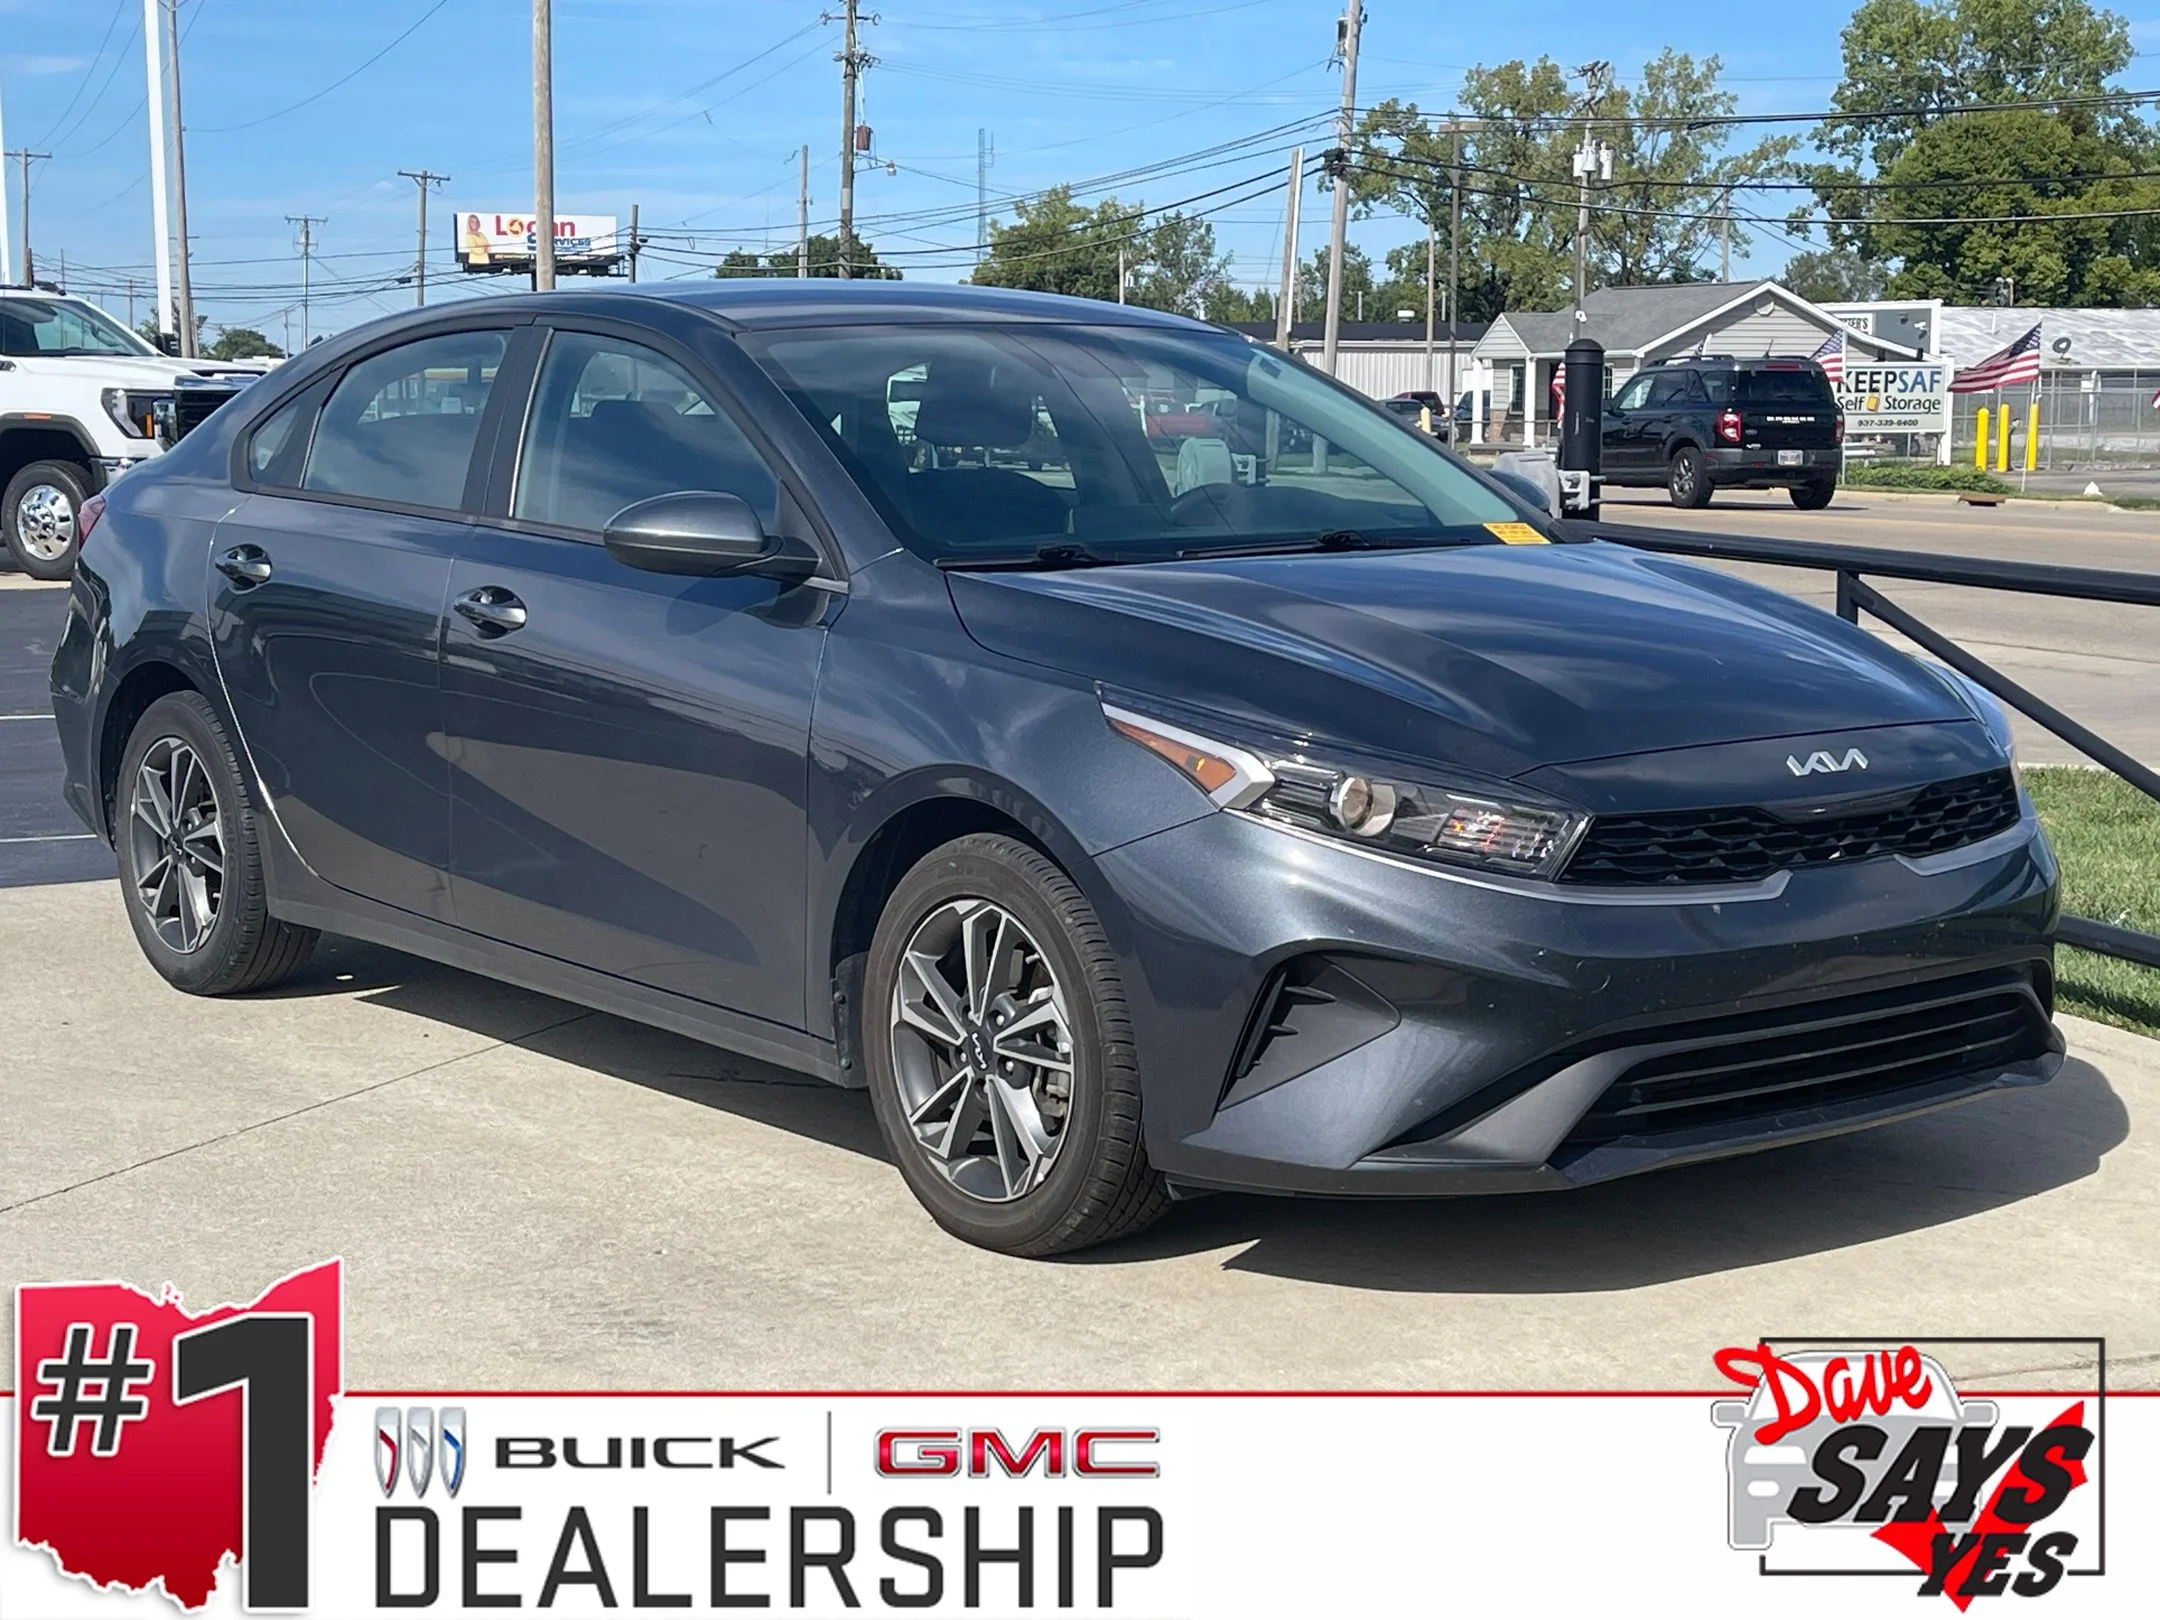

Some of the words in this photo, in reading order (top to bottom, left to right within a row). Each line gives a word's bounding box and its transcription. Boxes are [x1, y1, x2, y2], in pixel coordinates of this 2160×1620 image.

[1836, 395, 1864, 411] Self
[1884, 395, 1941, 414] Storage
[1786, 748, 1868, 776] KIA
